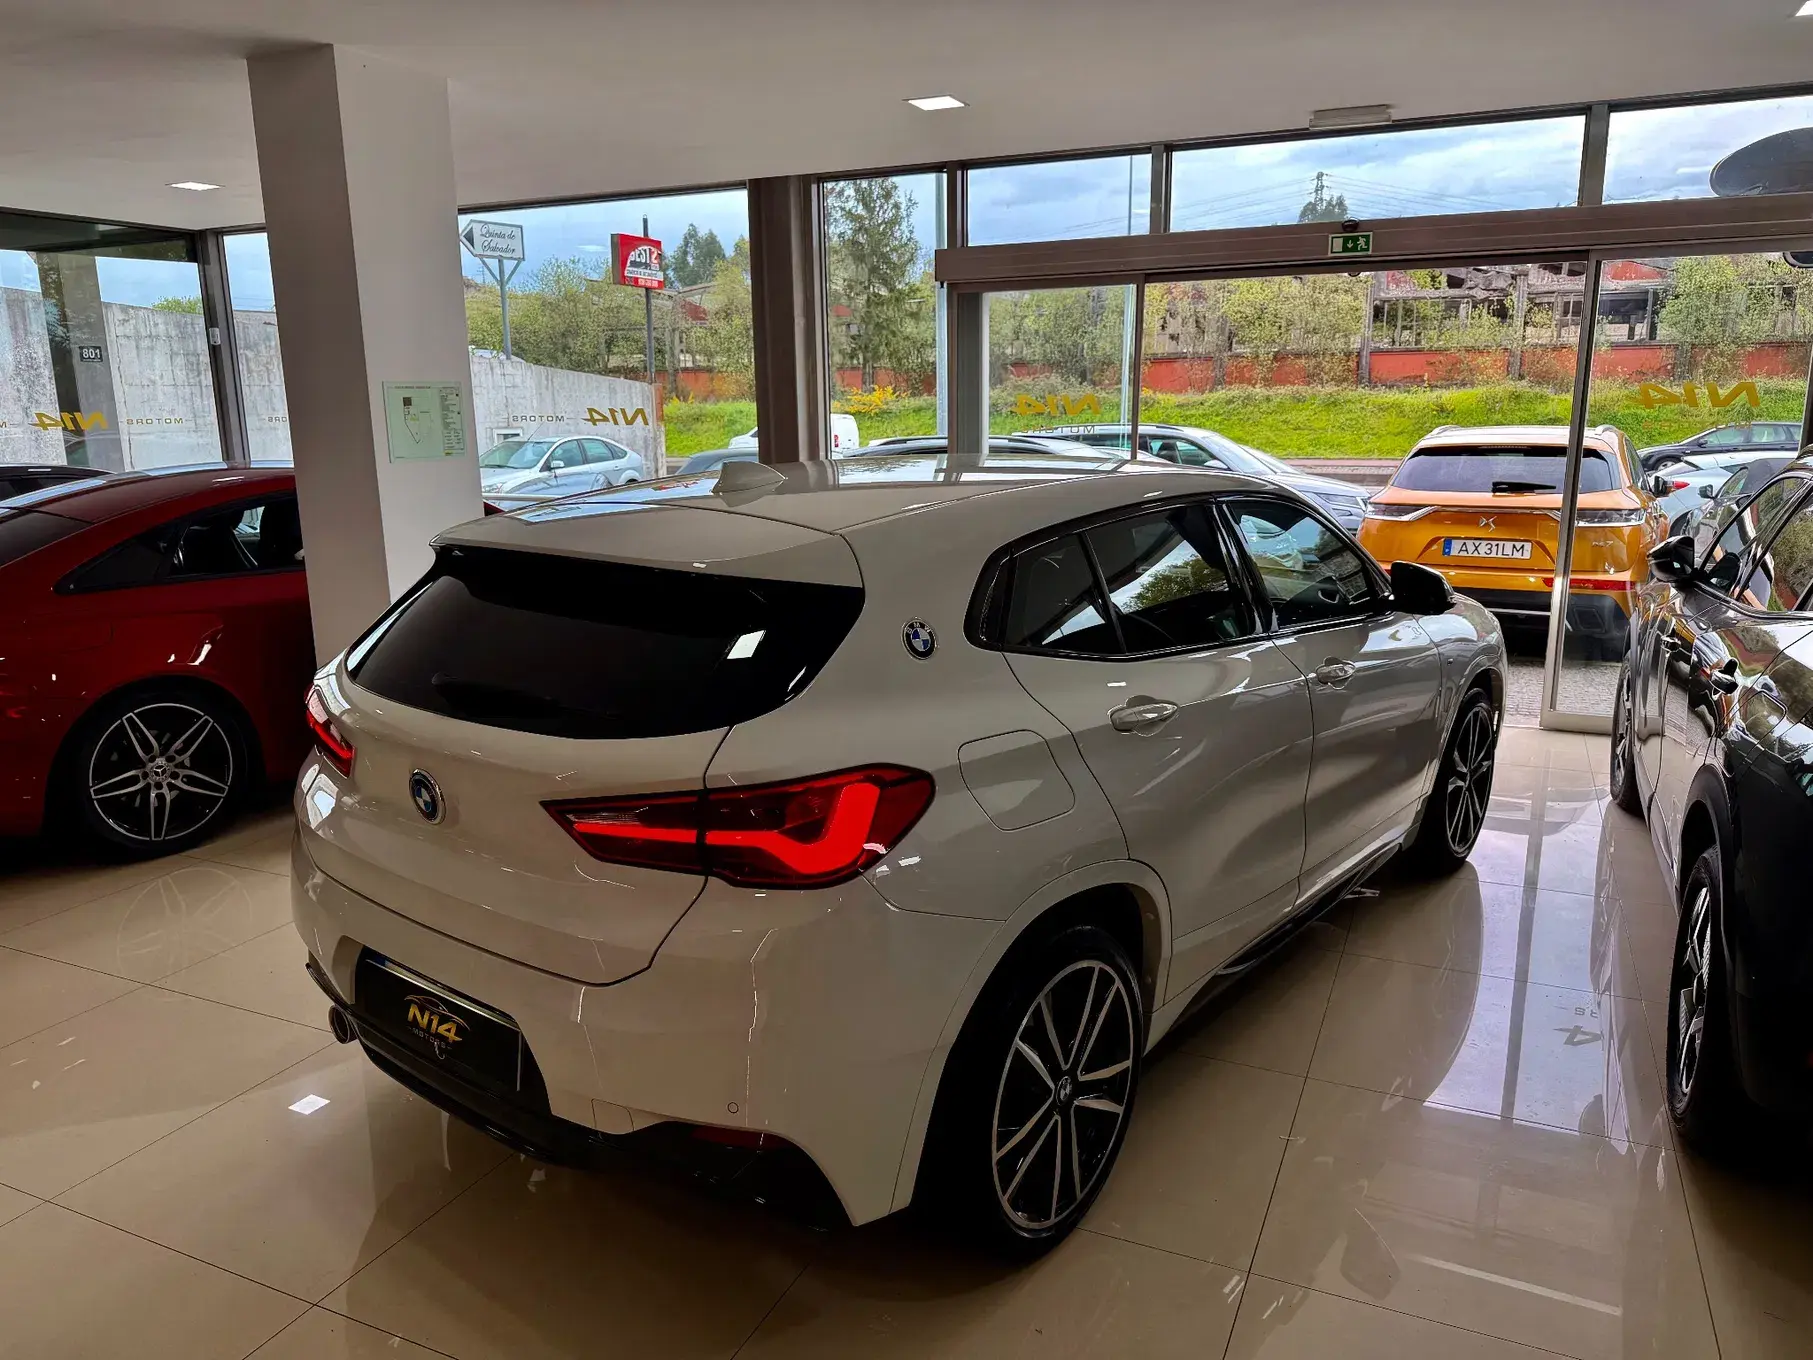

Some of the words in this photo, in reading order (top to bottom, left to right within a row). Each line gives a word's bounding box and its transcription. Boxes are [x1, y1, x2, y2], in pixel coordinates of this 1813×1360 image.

[506, 230, 516, 240] de
[481, 239, 515, 254] Salvador
[82, 348, 101, 359] 801
[407, 1003, 463, 1043] N14
